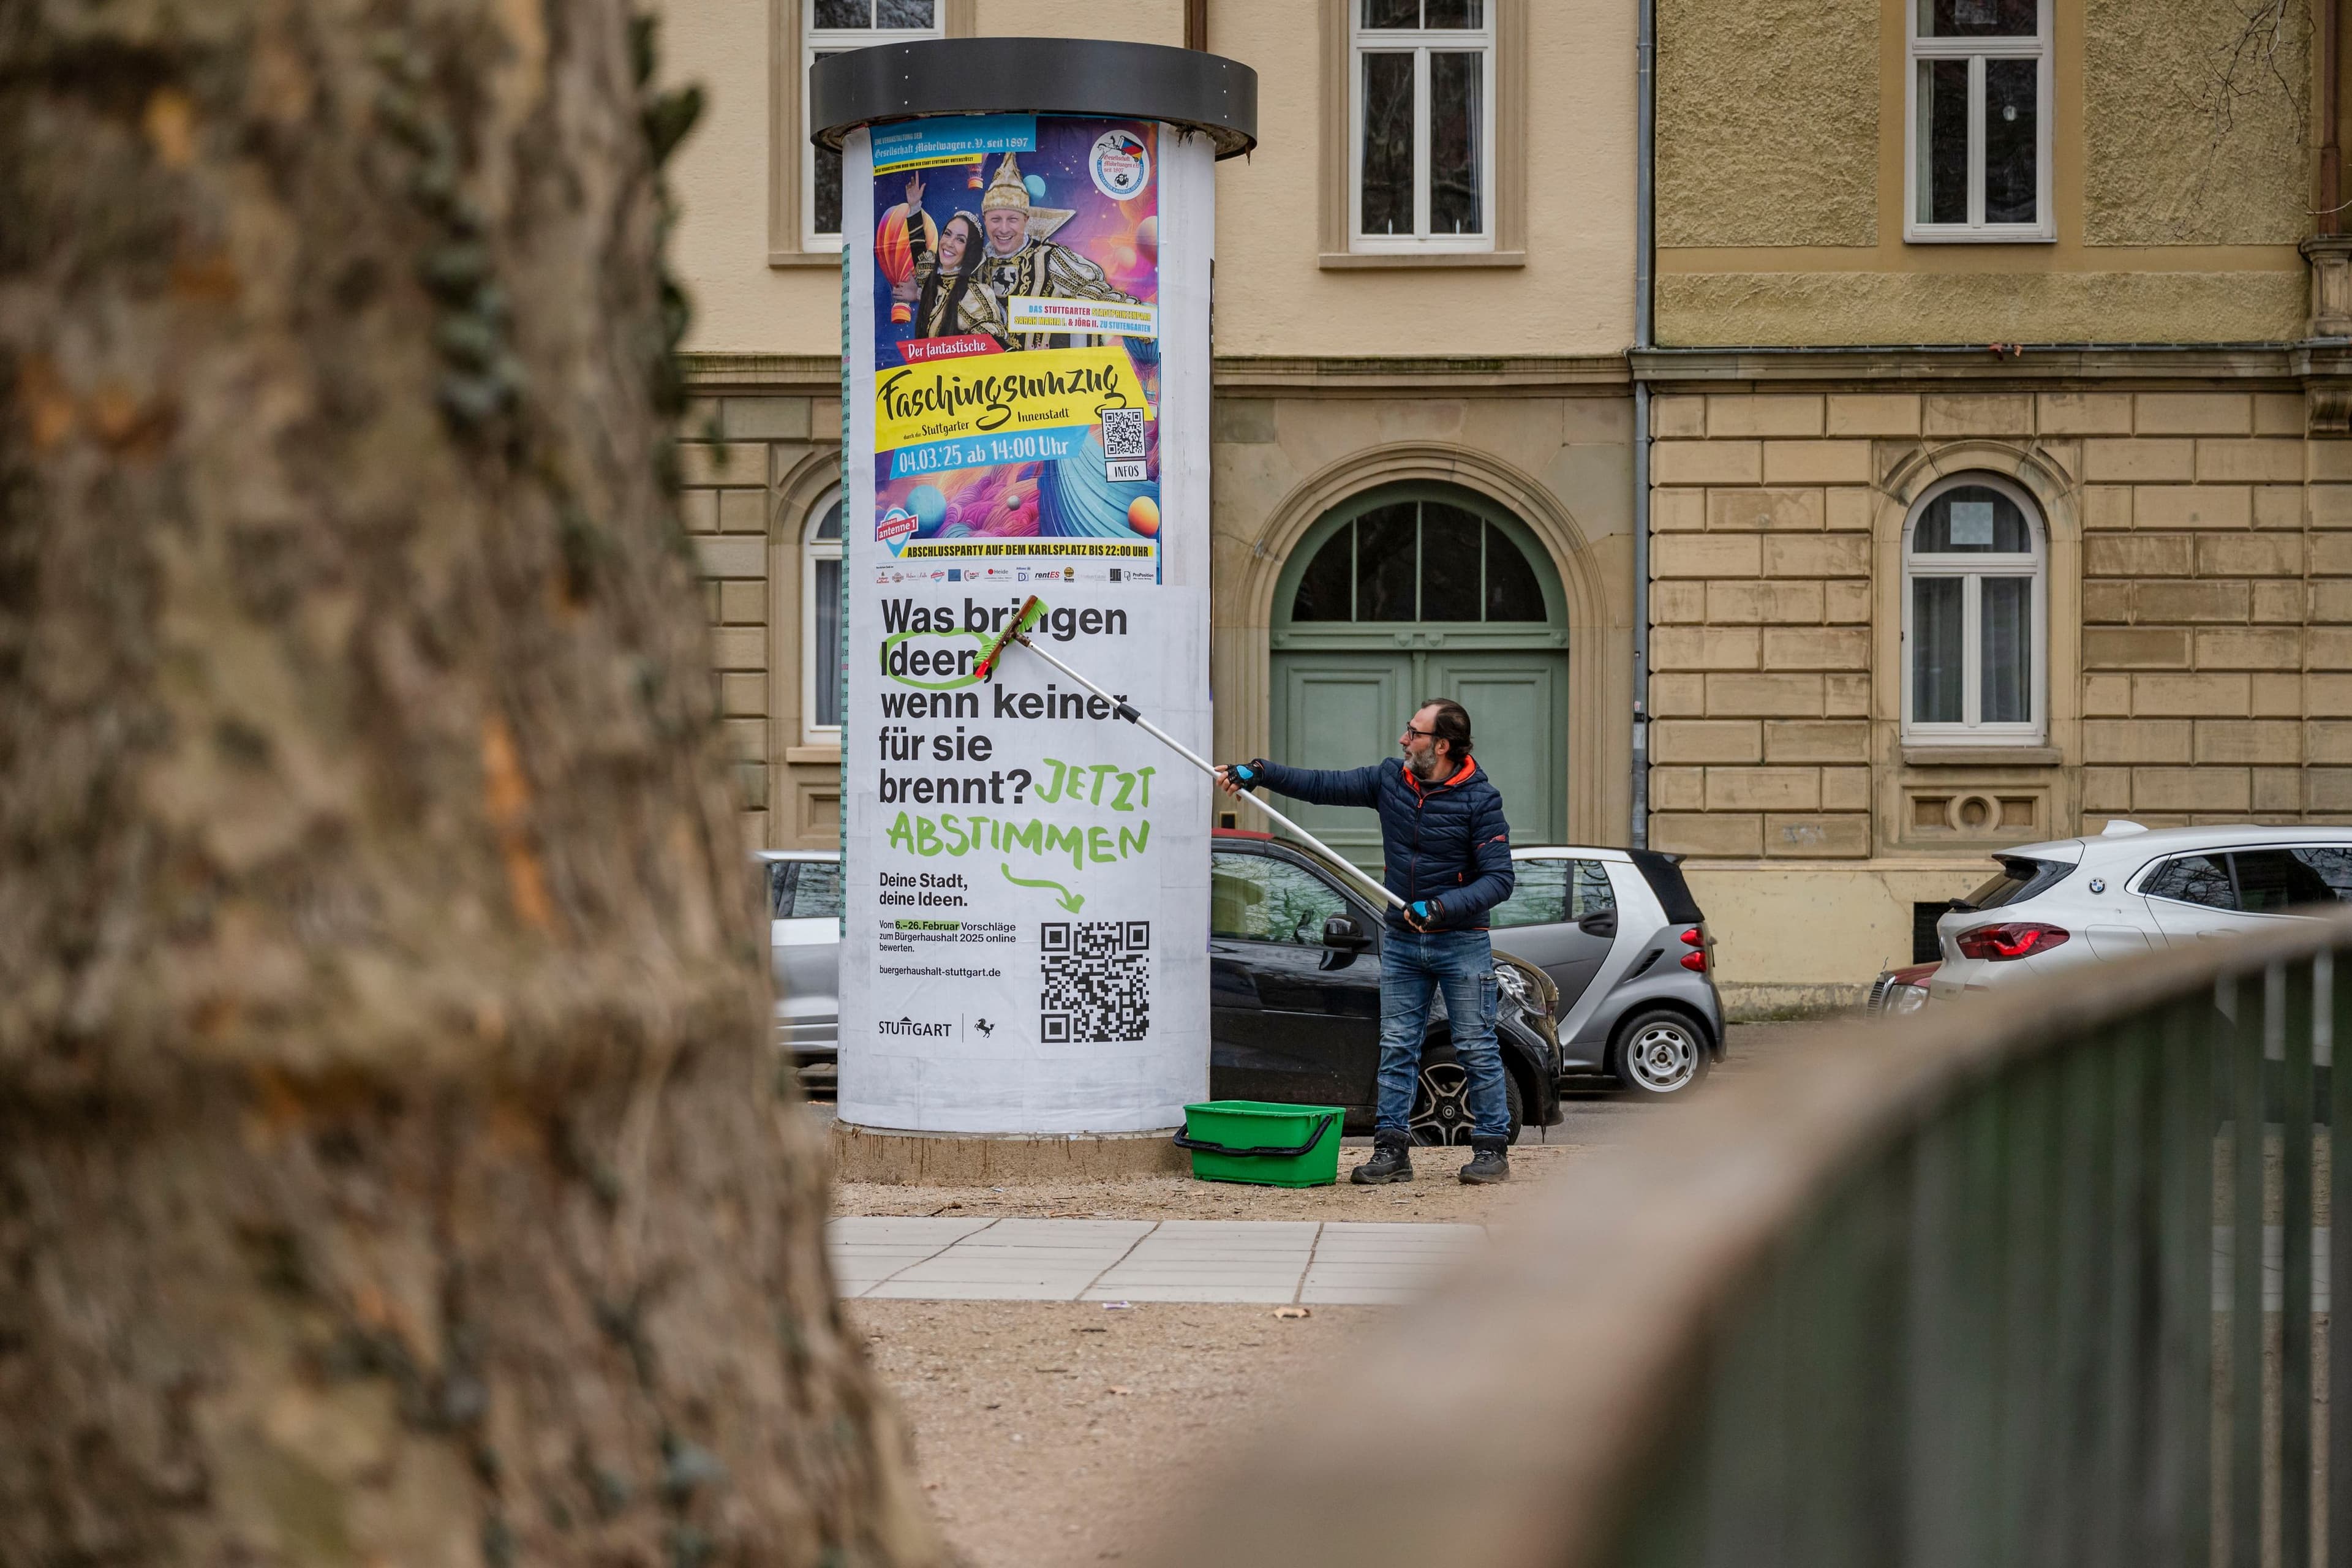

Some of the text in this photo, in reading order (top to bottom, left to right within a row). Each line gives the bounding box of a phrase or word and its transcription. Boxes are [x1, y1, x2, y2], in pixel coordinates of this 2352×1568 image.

[875, 144, 913, 158] Gesellschaft
[914, 141, 968, 153] Möbelwagen
[987, 138, 1003, 148] seit
[1006, 137, 1028, 148] 1897
[1044, 306, 1090, 315] STUTTGARTER
[1014, 316, 1038, 325] SARAH
[1038, 317, 1061, 326] MARIA
[1068, 318, 1073, 327] &
[1075, 317, 1090, 328] JÖRG
[1100, 320, 1107, 329] ZU
[1108, 321, 1151, 333] STUTENGARTEN
[908, 339, 987, 358] Der fantastische
[876, 364, 1127, 431] Faschingsumzug
[922, 420, 970, 436] Stuttgarter
[1017, 408, 1070, 423] Innenstadt
[967, 445, 986, 464] ab
[991, 437, 1035, 461] 14:00
[1039, 435, 1068, 456] Uhr
[1115, 466, 1139, 477] INFOS
[879, 519, 916, 538] antenne 1
[908, 545, 1148, 557] ABSCHLUSSPARTY AUF DEM KARLSPLATZ BIS 22:00 UHR
[881, 598, 954, 633] Was
[881, 684, 1127, 720] wenn keiner
[879, 726, 992, 761] für sie
[879, 758, 1156, 812] brennt? JETZT
[886, 811, 1150, 870] ABSTIMMEN
[880, 872, 968, 891] Deine Stadt,
[880, 891, 968, 907] deine Ideen.
[879, 920, 894, 929] Vom
[923, 921, 959, 930] Februar
[961, 922, 1016, 933] Vorschläge
[895, 932, 958, 942] Bürgerhaushalt
[986, 934, 1016, 943] online
[880, 943, 914, 952] bewerten.
[880, 965, 1001, 978] buergerhaushalt-stuttgart.de
[879, 1017, 952, 1037] STUTTGART
